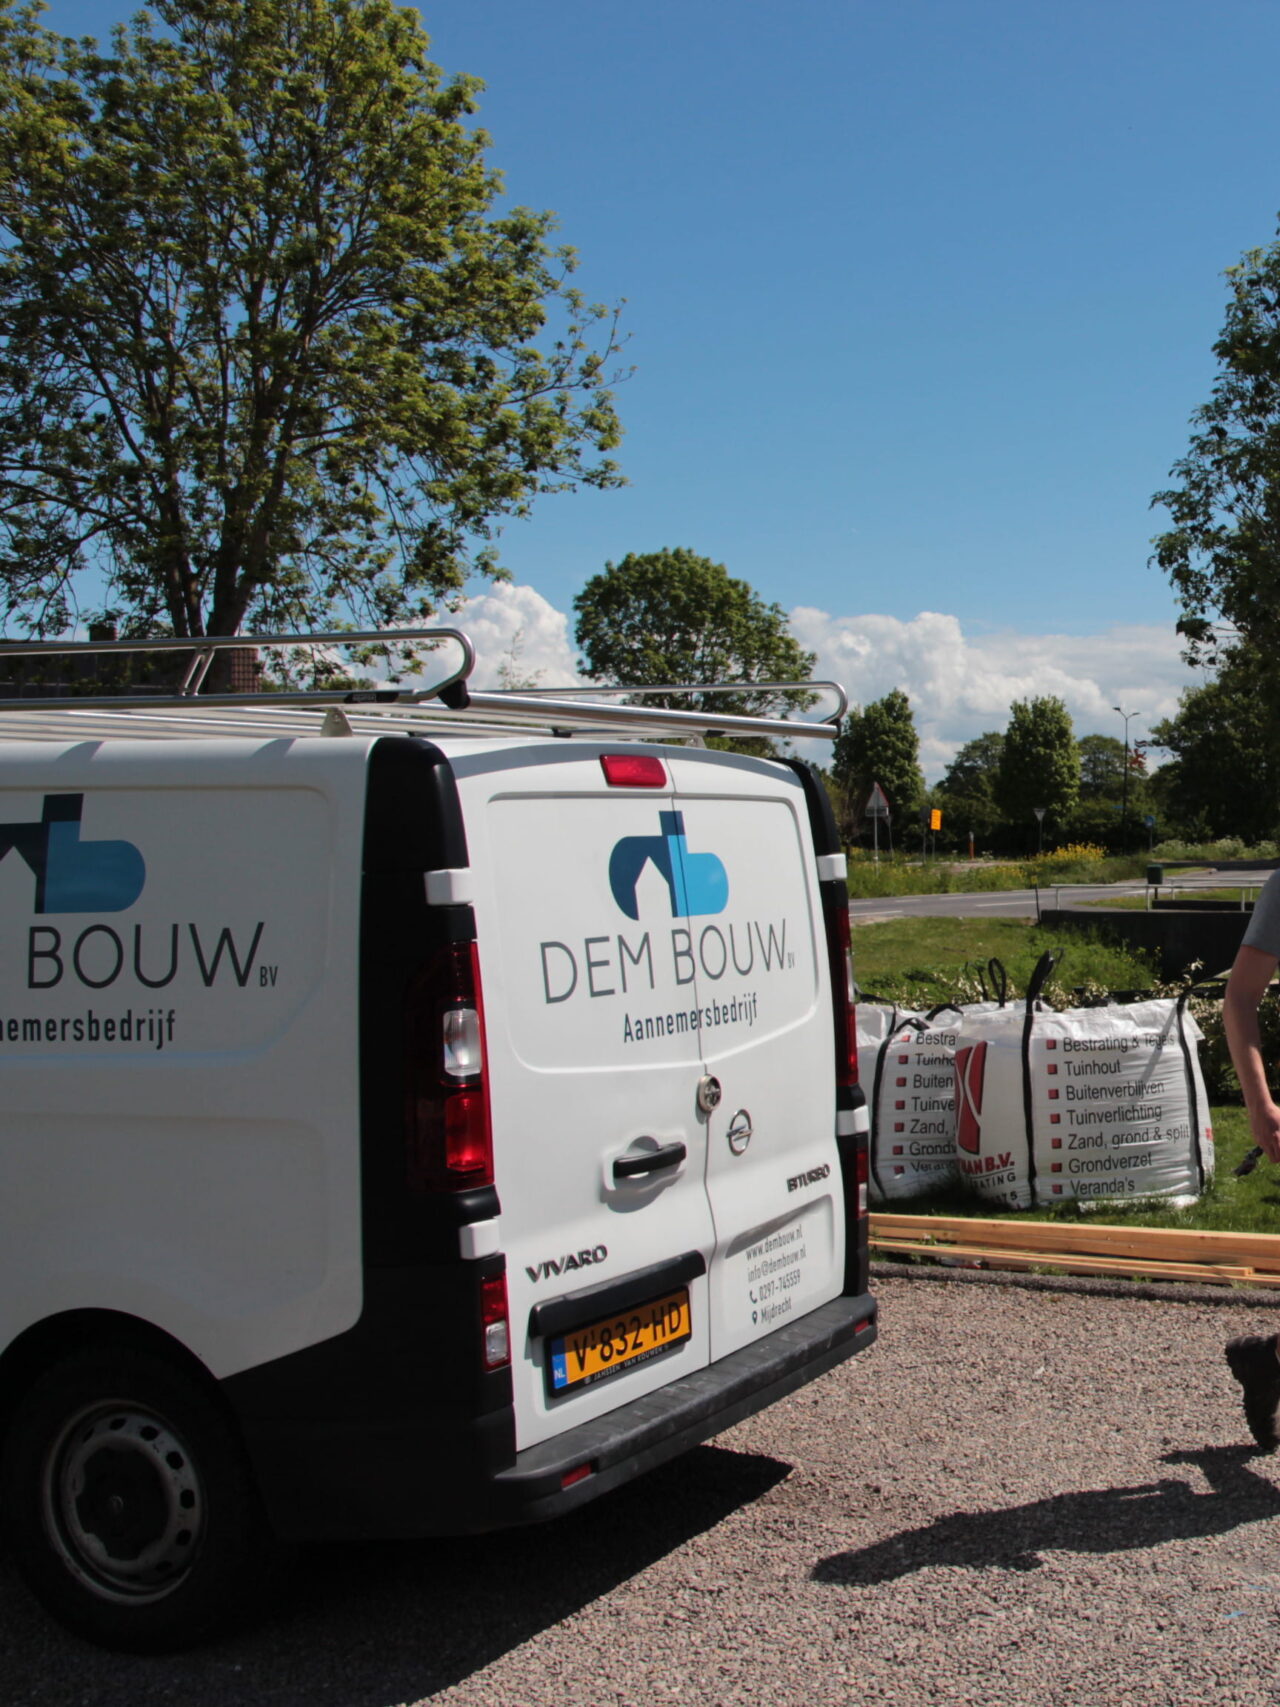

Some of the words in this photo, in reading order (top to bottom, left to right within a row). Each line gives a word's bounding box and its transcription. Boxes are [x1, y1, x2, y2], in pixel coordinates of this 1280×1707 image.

[28, 922, 264, 989] BOUW
[260, 966, 278, 987] BV
[540, 932, 655, 1004] DEM
[671, 918, 786, 986] BOUW
[624, 992, 758, 1043] Aannemersbedrijf
[916, 1031, 959, 1045] Bestra
[1063, 1036, 1128, 1053] Bestrating
[1064, 1059, 1121, 1077] Tuinhout
[913, 1074, 953, 1089] Buiten
[1066, 1081, 1165, 1101] Buitenverblijven
[1066, 1105, 1162, 1125] Tuinverlichting
[910, 1119, 949, 1136] Zand,
[1068, 1132, 1108, 1150] Zand,
[1112, 1128, 1149, 1149] grond
[1153, 1127, 1162, 1140] &
[984, 1152, 1016, 1172] B.V.
[1069, 1152, 1153, 1174] Grondverzet
[787, 1163, 831, 1193] BITURBO
[1070, 1177, 1135, 1195] Veranda's
[746, 1224, 803, 1261] www.dembouw.nl
[525, 1244, 608, 1283] VIVARO
[747, 1243, 807, 1283] info@dembouw.nl
[760, 1296, 792, 1324] Mijdrecht
[554, 1367, 566, 1380] NL
